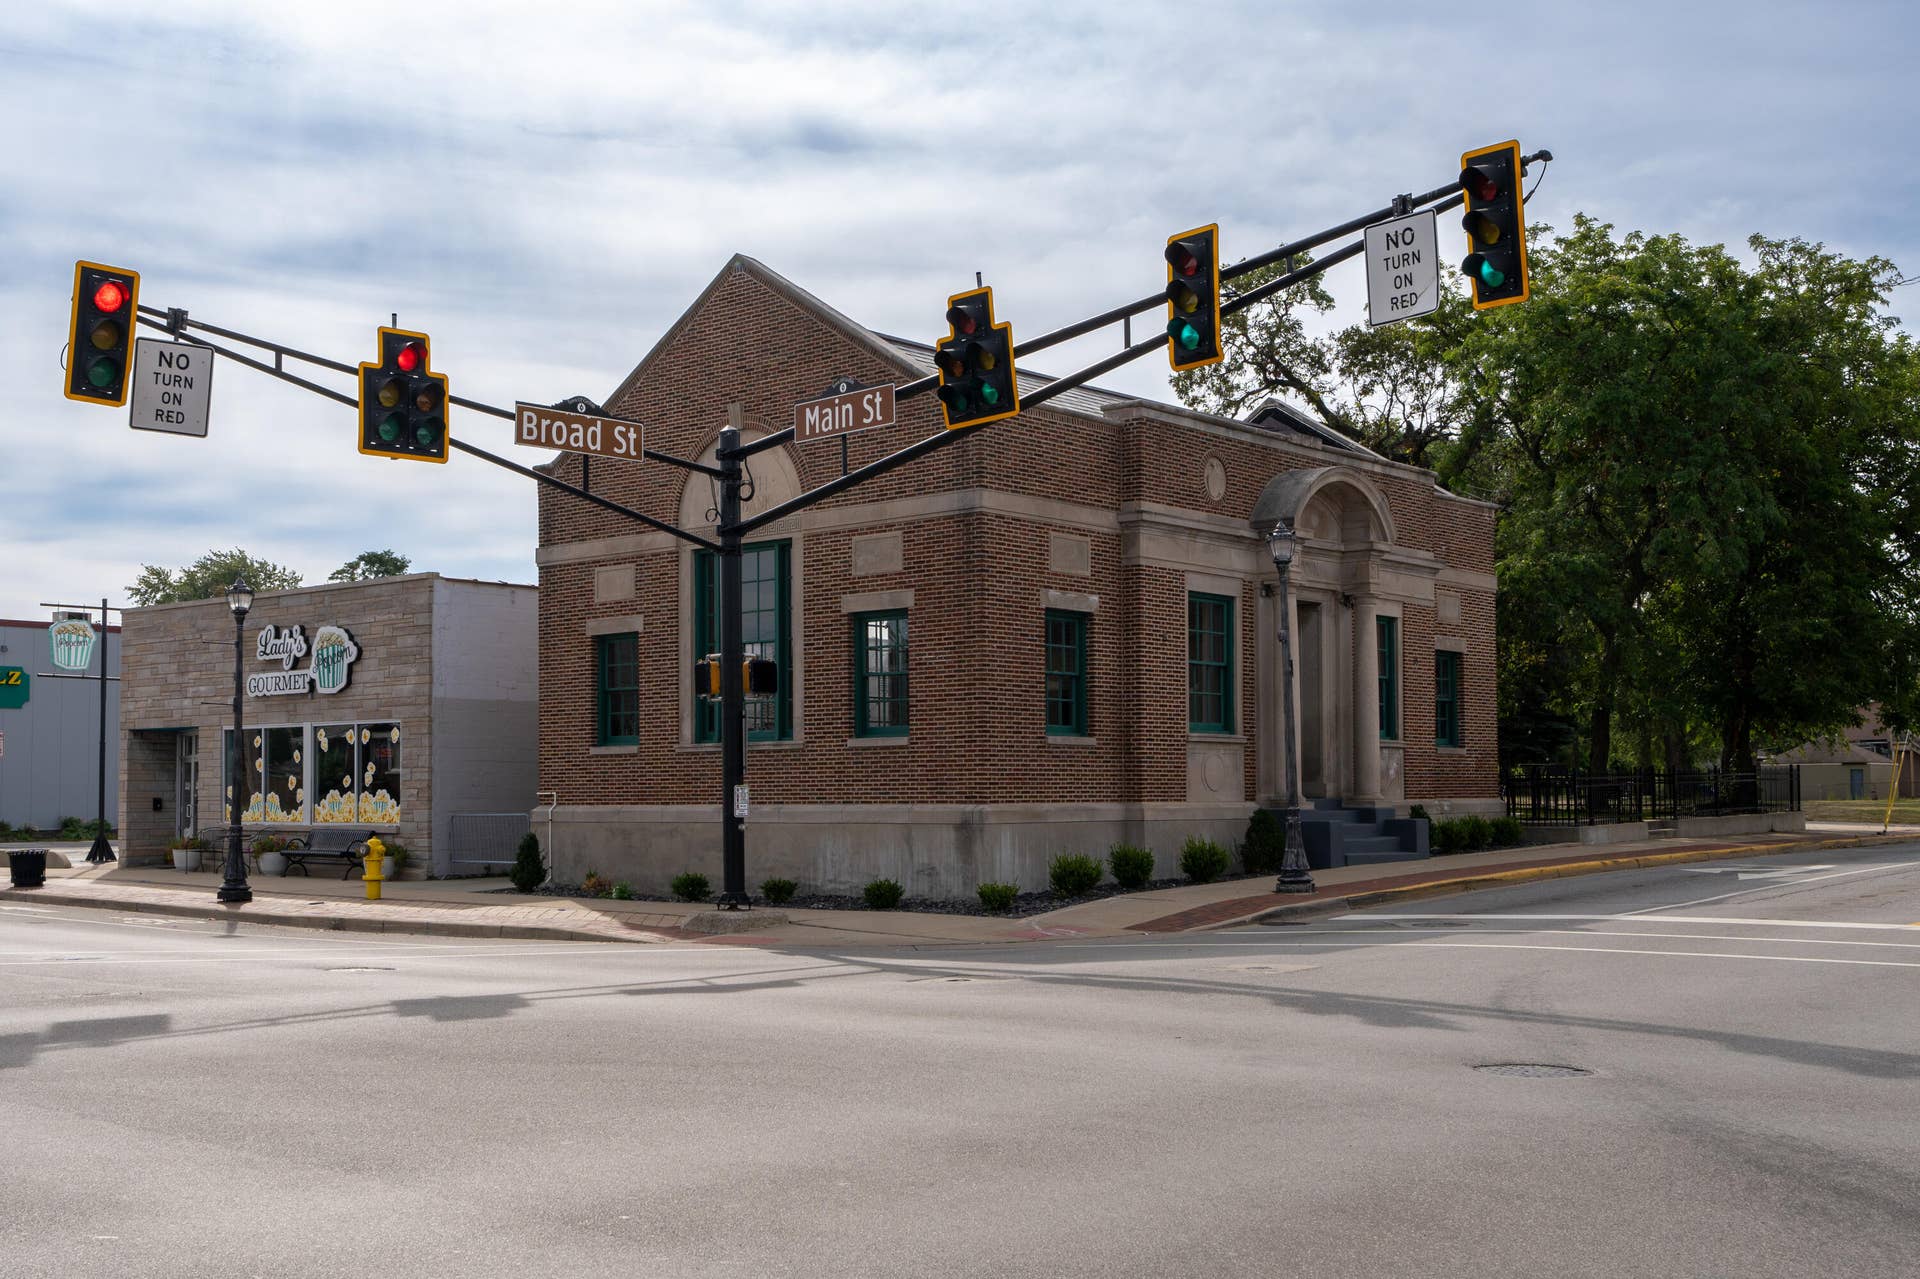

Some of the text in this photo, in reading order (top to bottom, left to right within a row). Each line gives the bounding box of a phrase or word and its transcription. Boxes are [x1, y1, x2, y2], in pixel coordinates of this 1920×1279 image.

[1385, 227, 1415, 251] NO
[1383, 249, 1421, 272] TURN
[1394, 272, 1413, 290] ON
[1390, 292, 1418, 311] RED
[158, 350, 190, 371] NO
[153, 371, 194, 390] TURN
[161, 391, 182, 406] ON
[155, 408, 185, 425] RED
[805, 391, 883, 436] Main St
[522, 411, 637, 456] Broad St
[58, 637, 89, 649] Popcorn
[258, 628, 304, 666] Lady's
[312, 646, 353, 674] Popcorn
[248, 673, 309, 694] GOURMET
